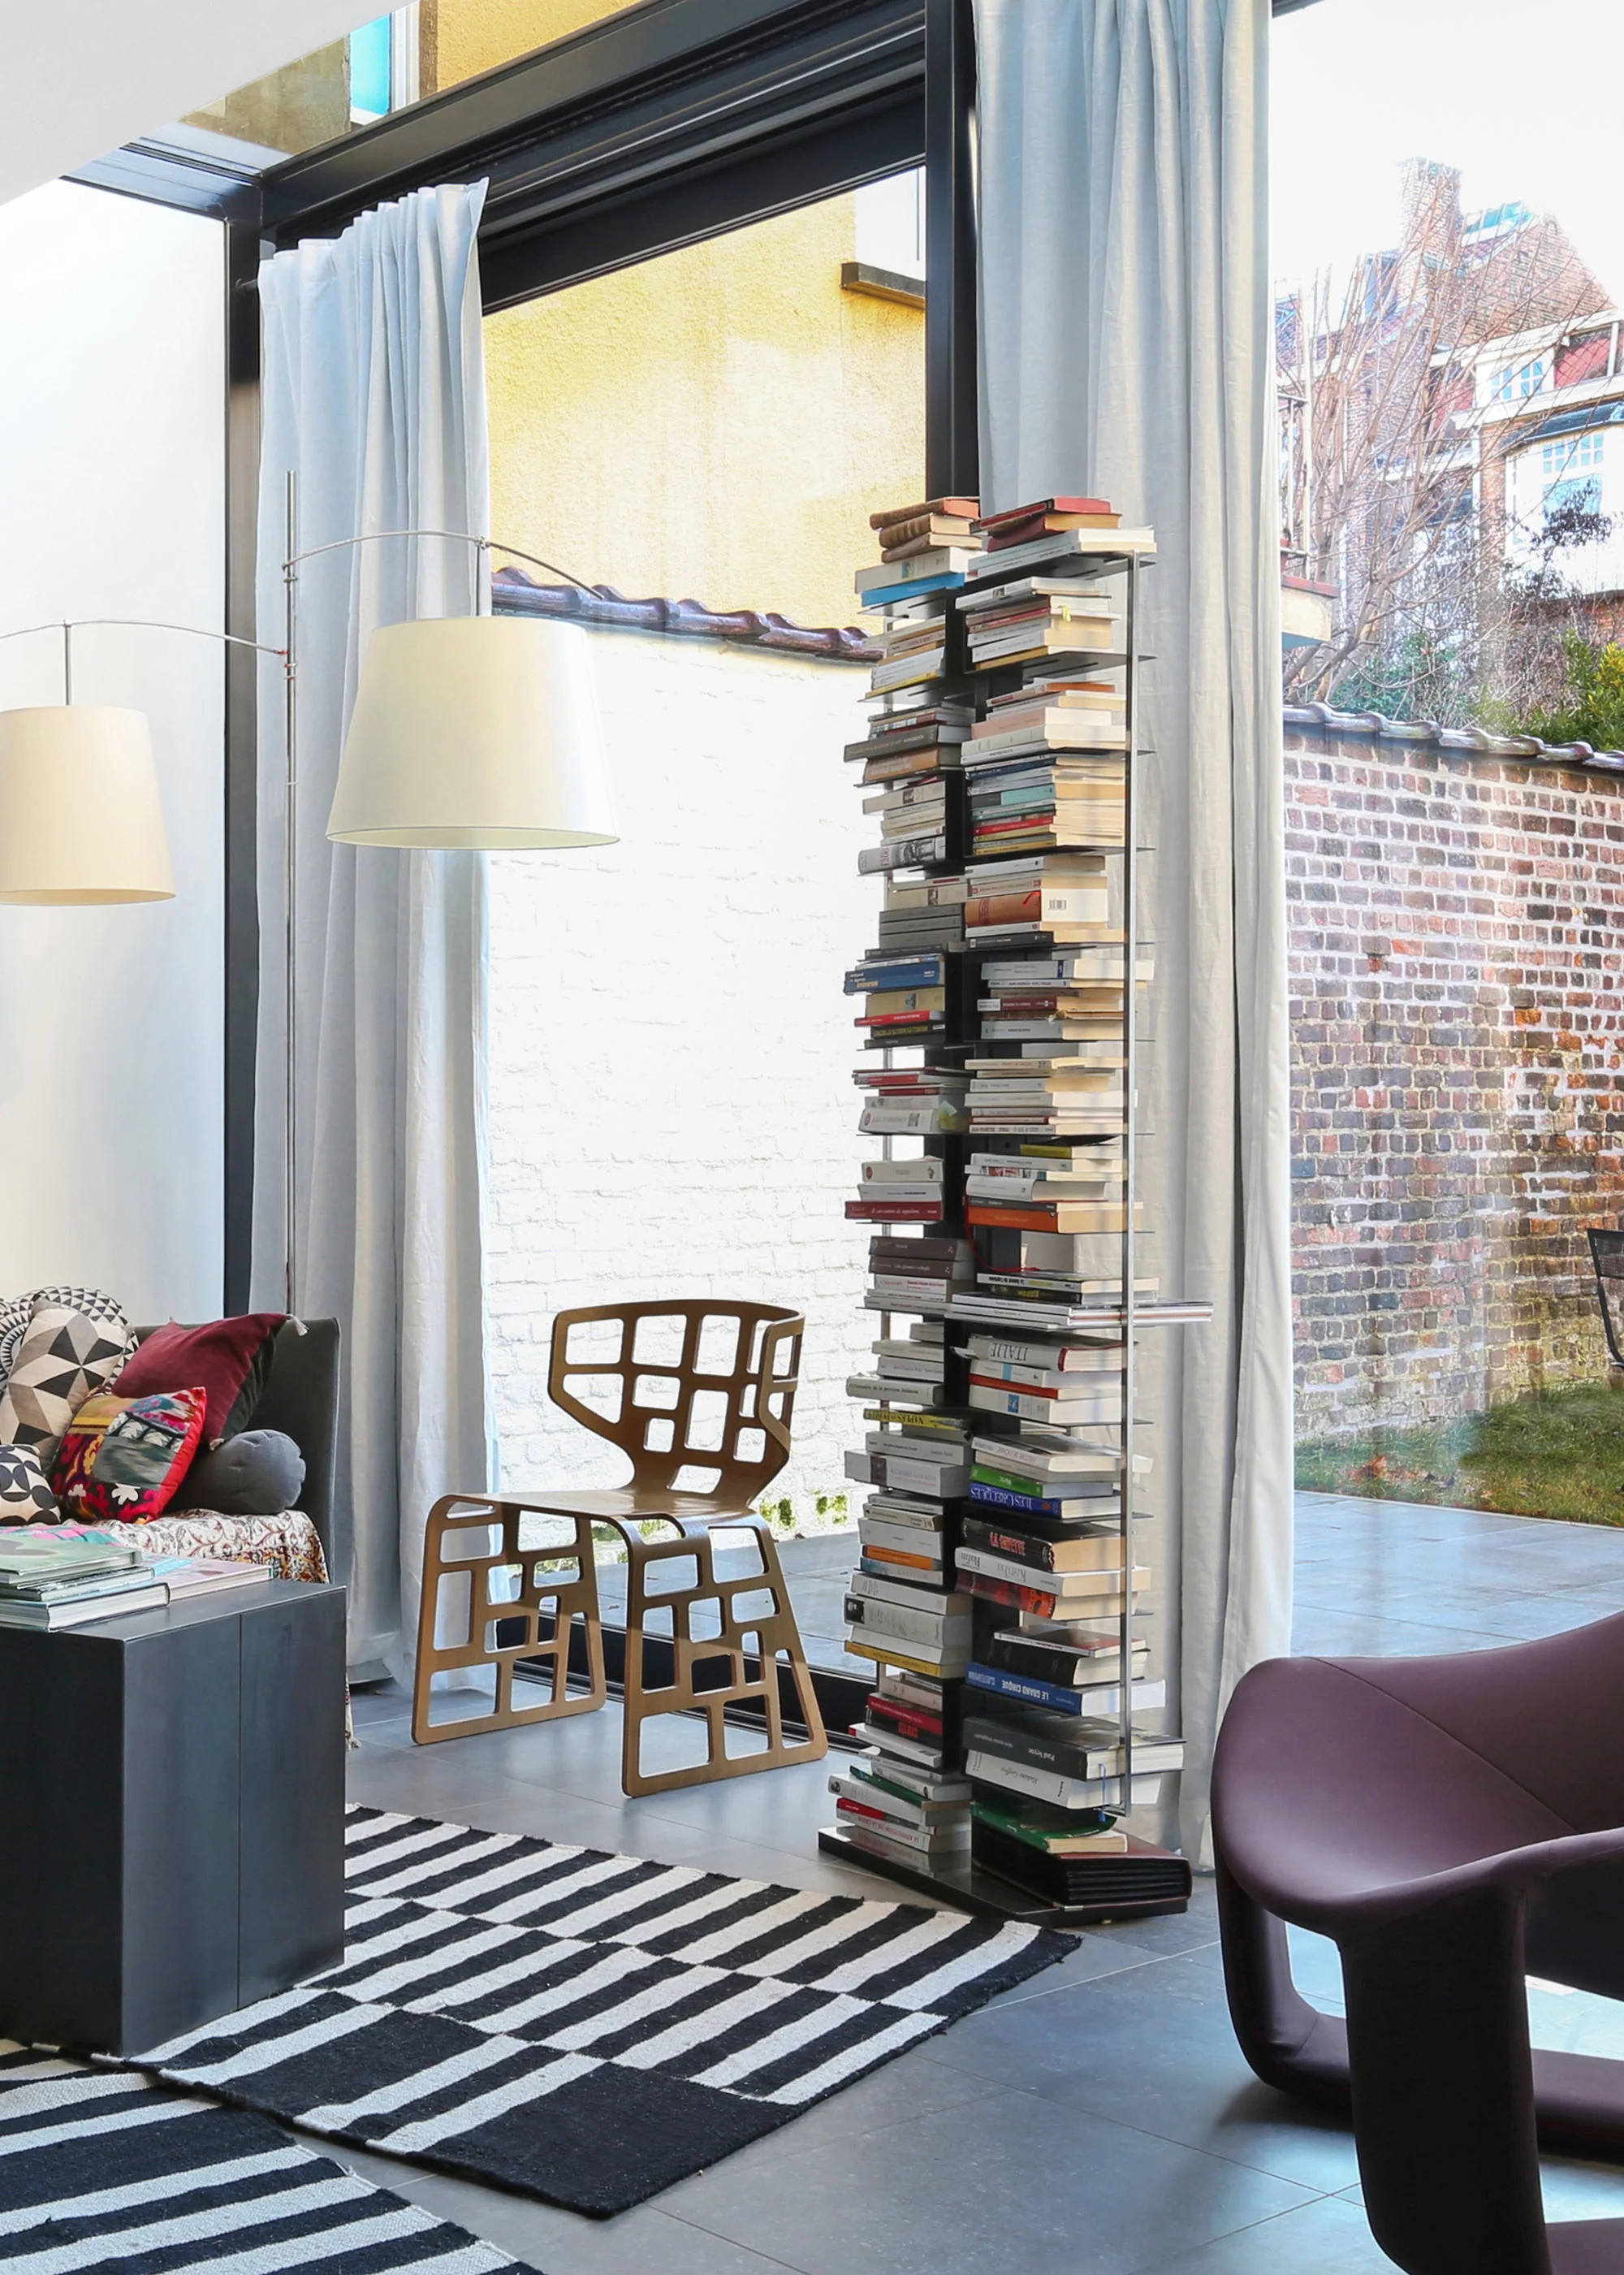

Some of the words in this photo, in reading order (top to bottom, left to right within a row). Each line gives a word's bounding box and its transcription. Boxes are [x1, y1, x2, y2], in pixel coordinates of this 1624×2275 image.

[989, 1343, 1029, 1362] ITALIE
[1000, 1679, 1021, 1696] CIRQUE
[1020, 1684, 1040, 1699] GRAND
[1040, 1689, 1049, 1701] LE
